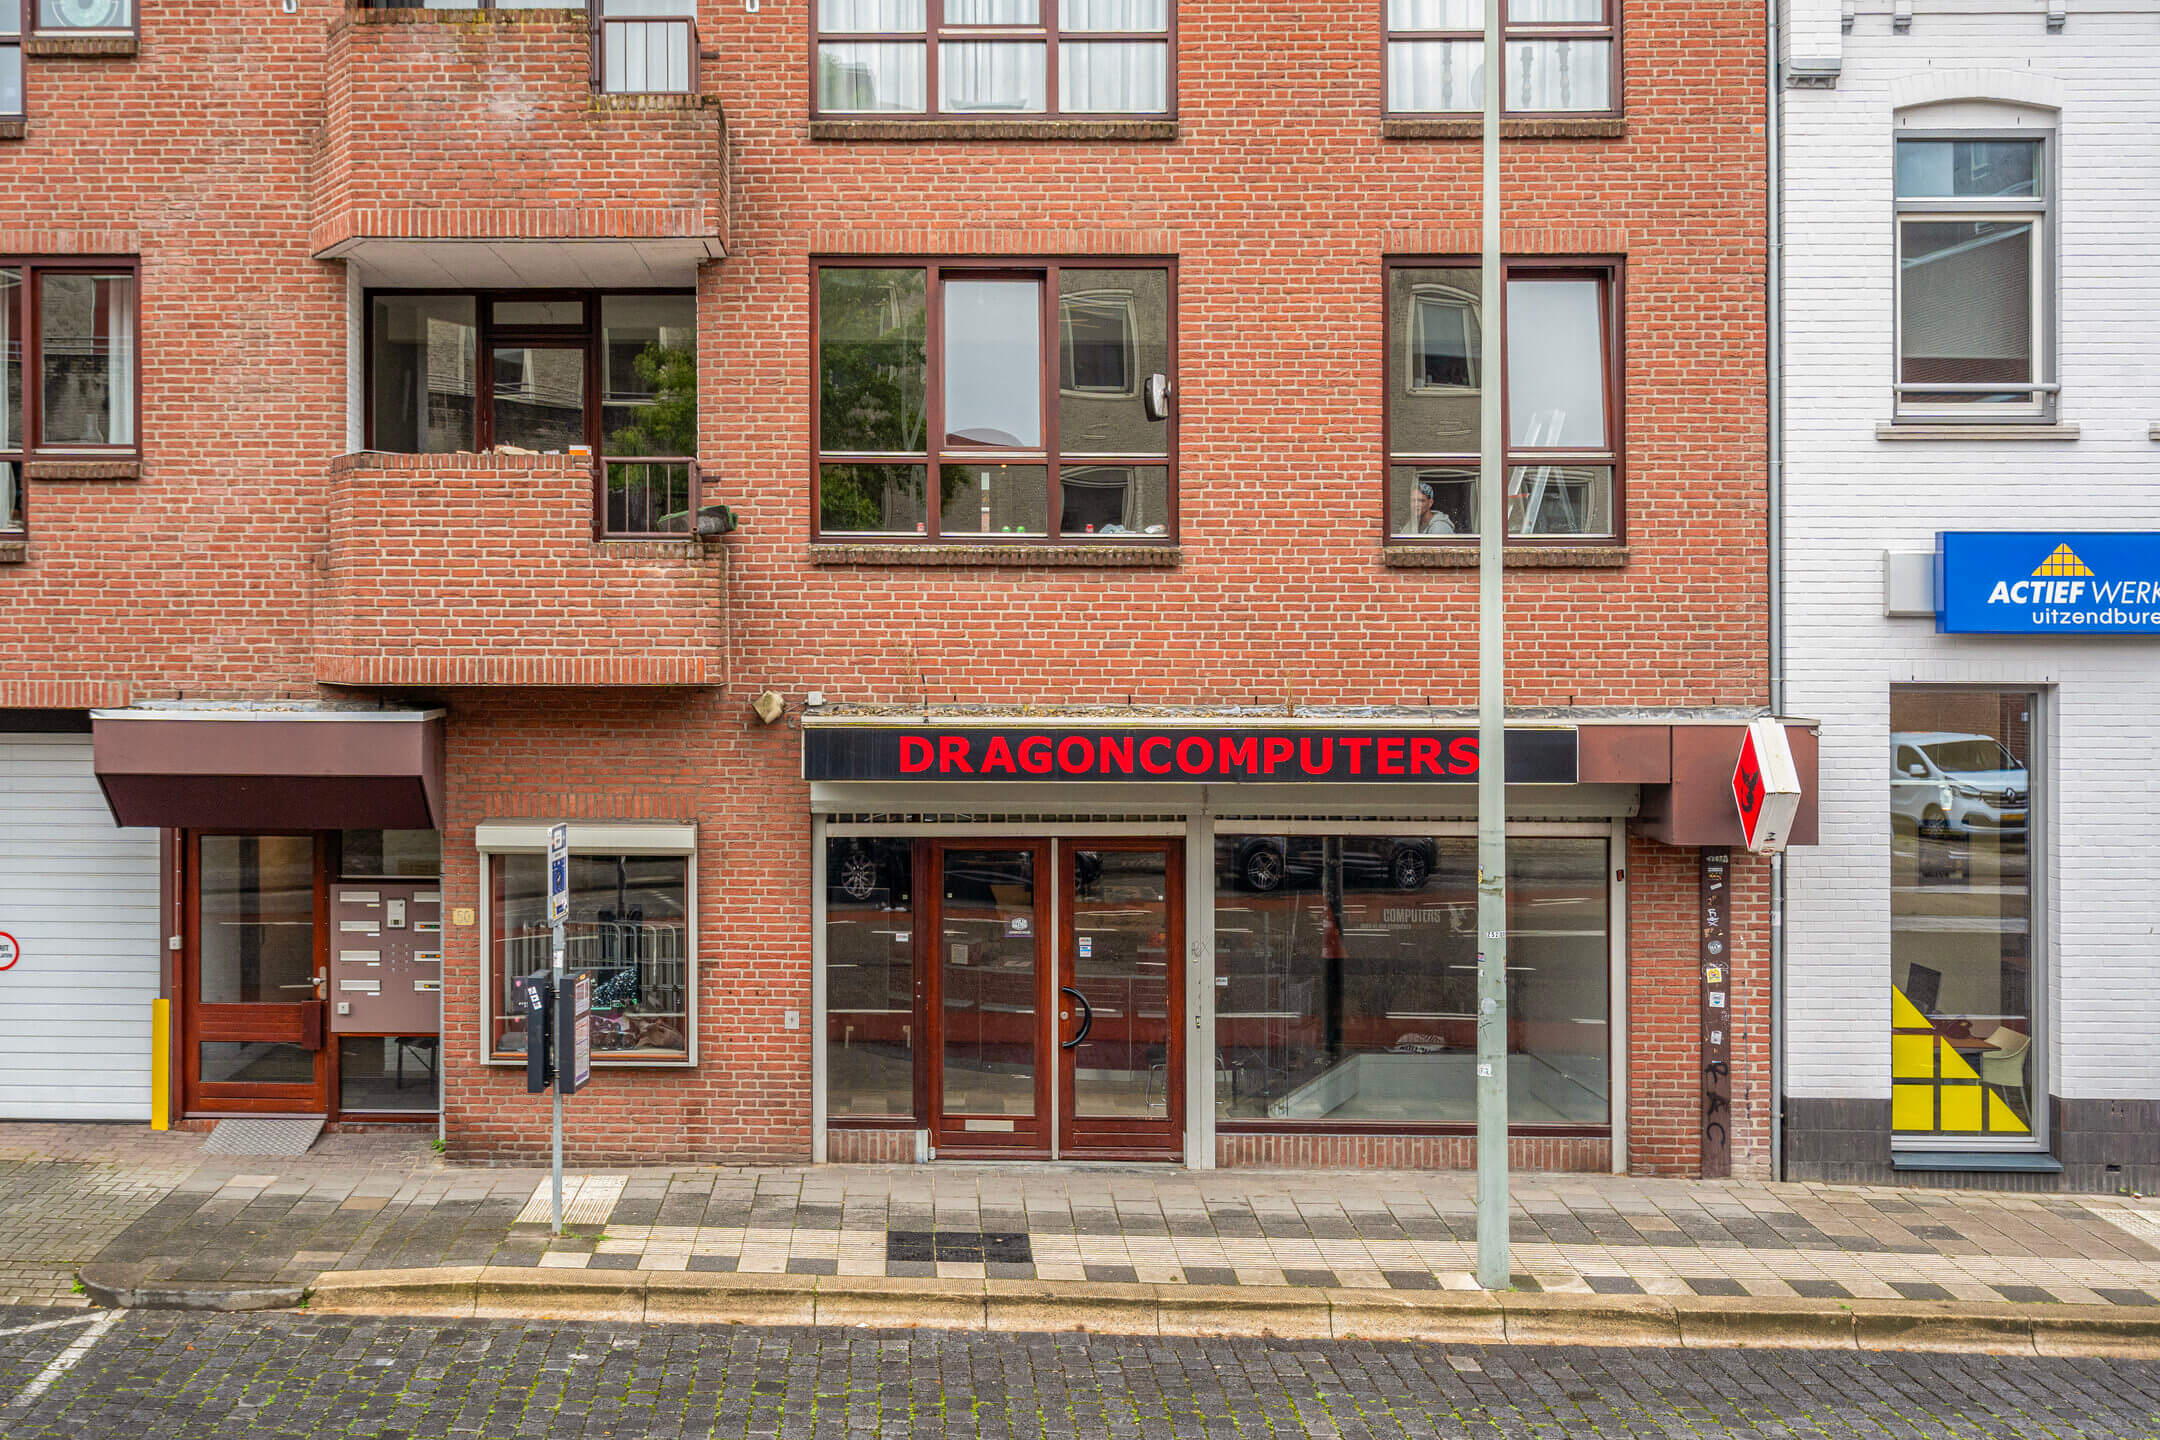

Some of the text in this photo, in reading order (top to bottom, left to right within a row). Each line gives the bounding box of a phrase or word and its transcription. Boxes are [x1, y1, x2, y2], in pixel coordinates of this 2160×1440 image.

[1987, 581, 2085, 604] ACTIEF
[2032, 608, 2160, 625] uitzendbure
[898, 735, 1479, 776] DRAGONCOMPUTERS
[1383, 908, 1441, 923] COMPUTERS
